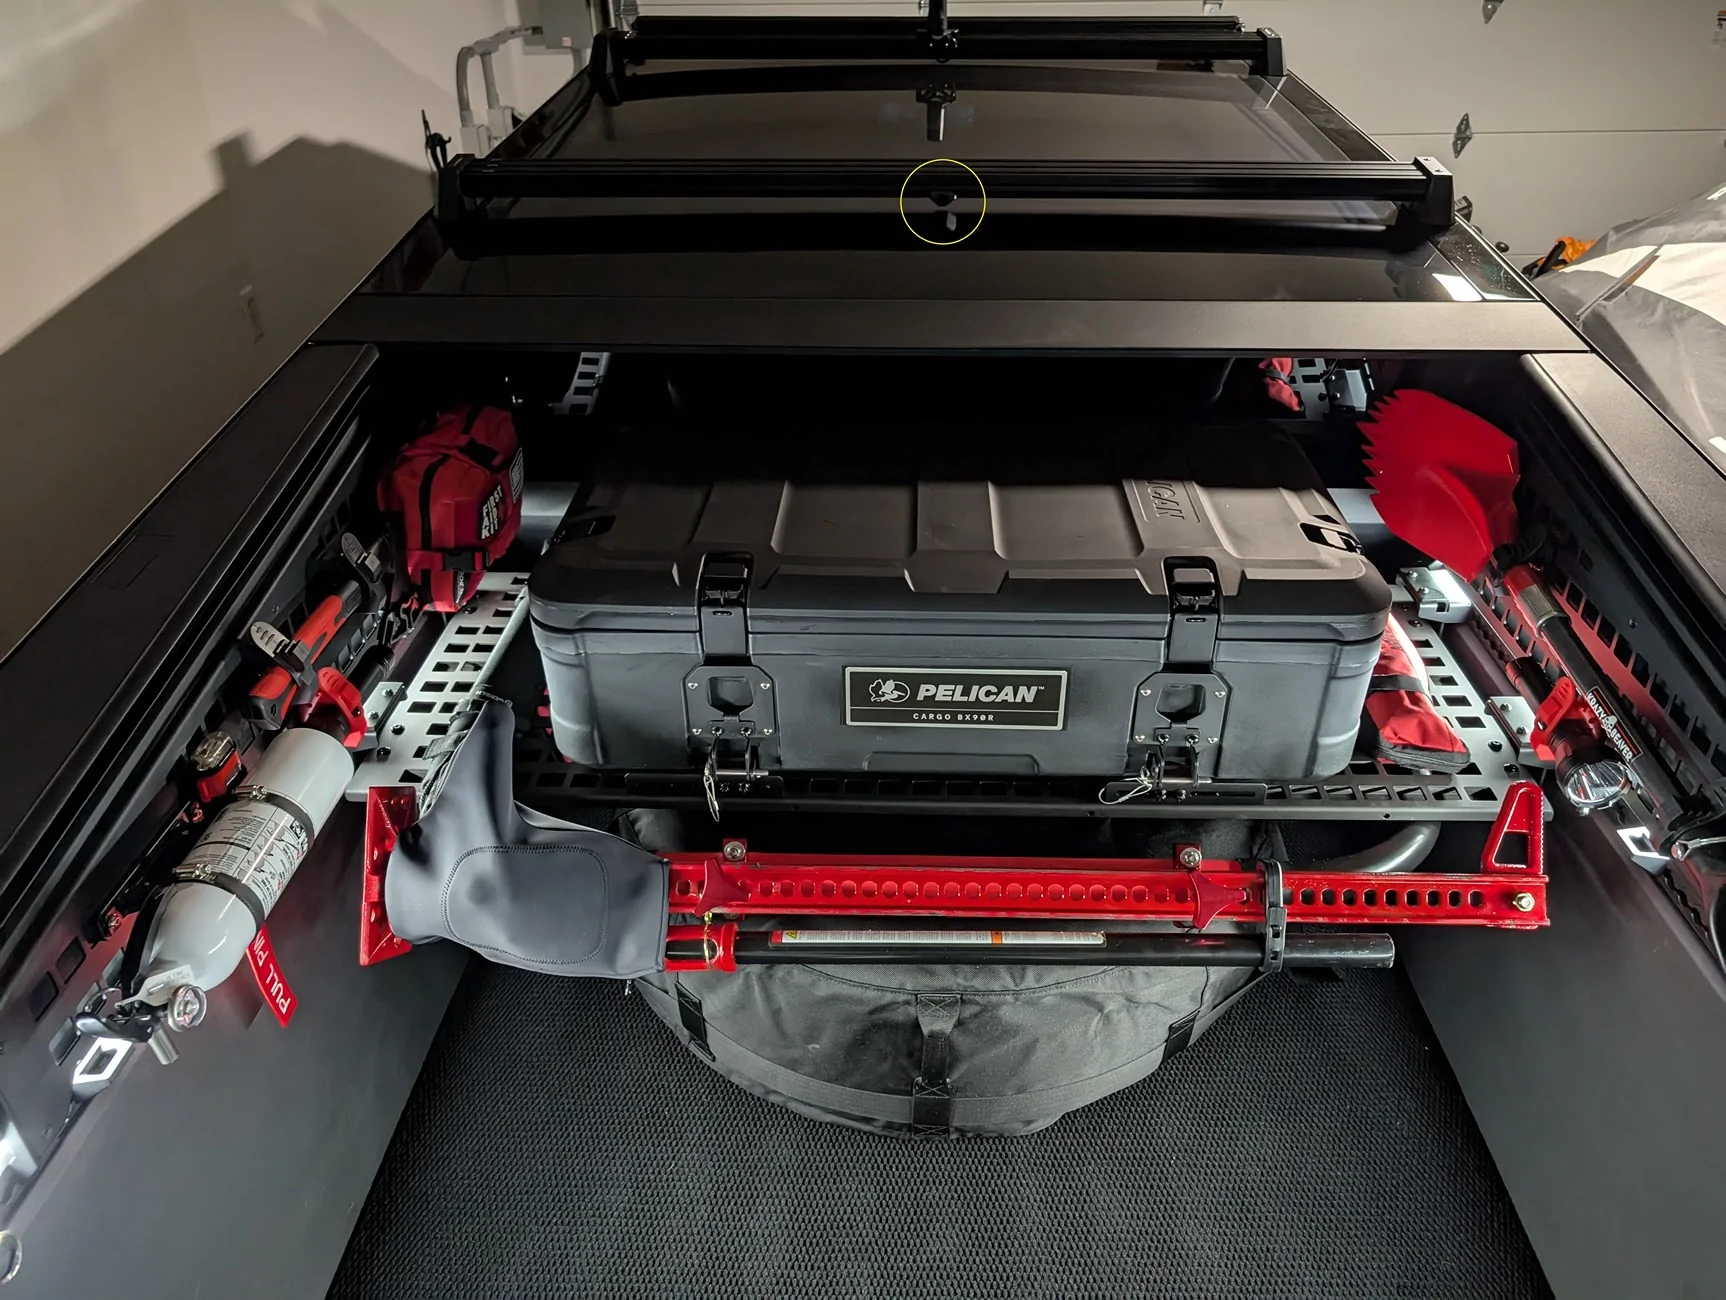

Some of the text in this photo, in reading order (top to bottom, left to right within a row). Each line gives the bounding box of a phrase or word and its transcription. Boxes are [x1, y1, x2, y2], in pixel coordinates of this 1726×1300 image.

[482, 485, 503, 517] FIRST
[481, 519, 499, 540] KIT
[482, 509, 498, 531] AID
[913, 712, 994, 722] CARGO BX90R
[1587, 692, 1634, 763] KRAZY BEAVER
[253, 929, 291, 1015] PULL PIN
